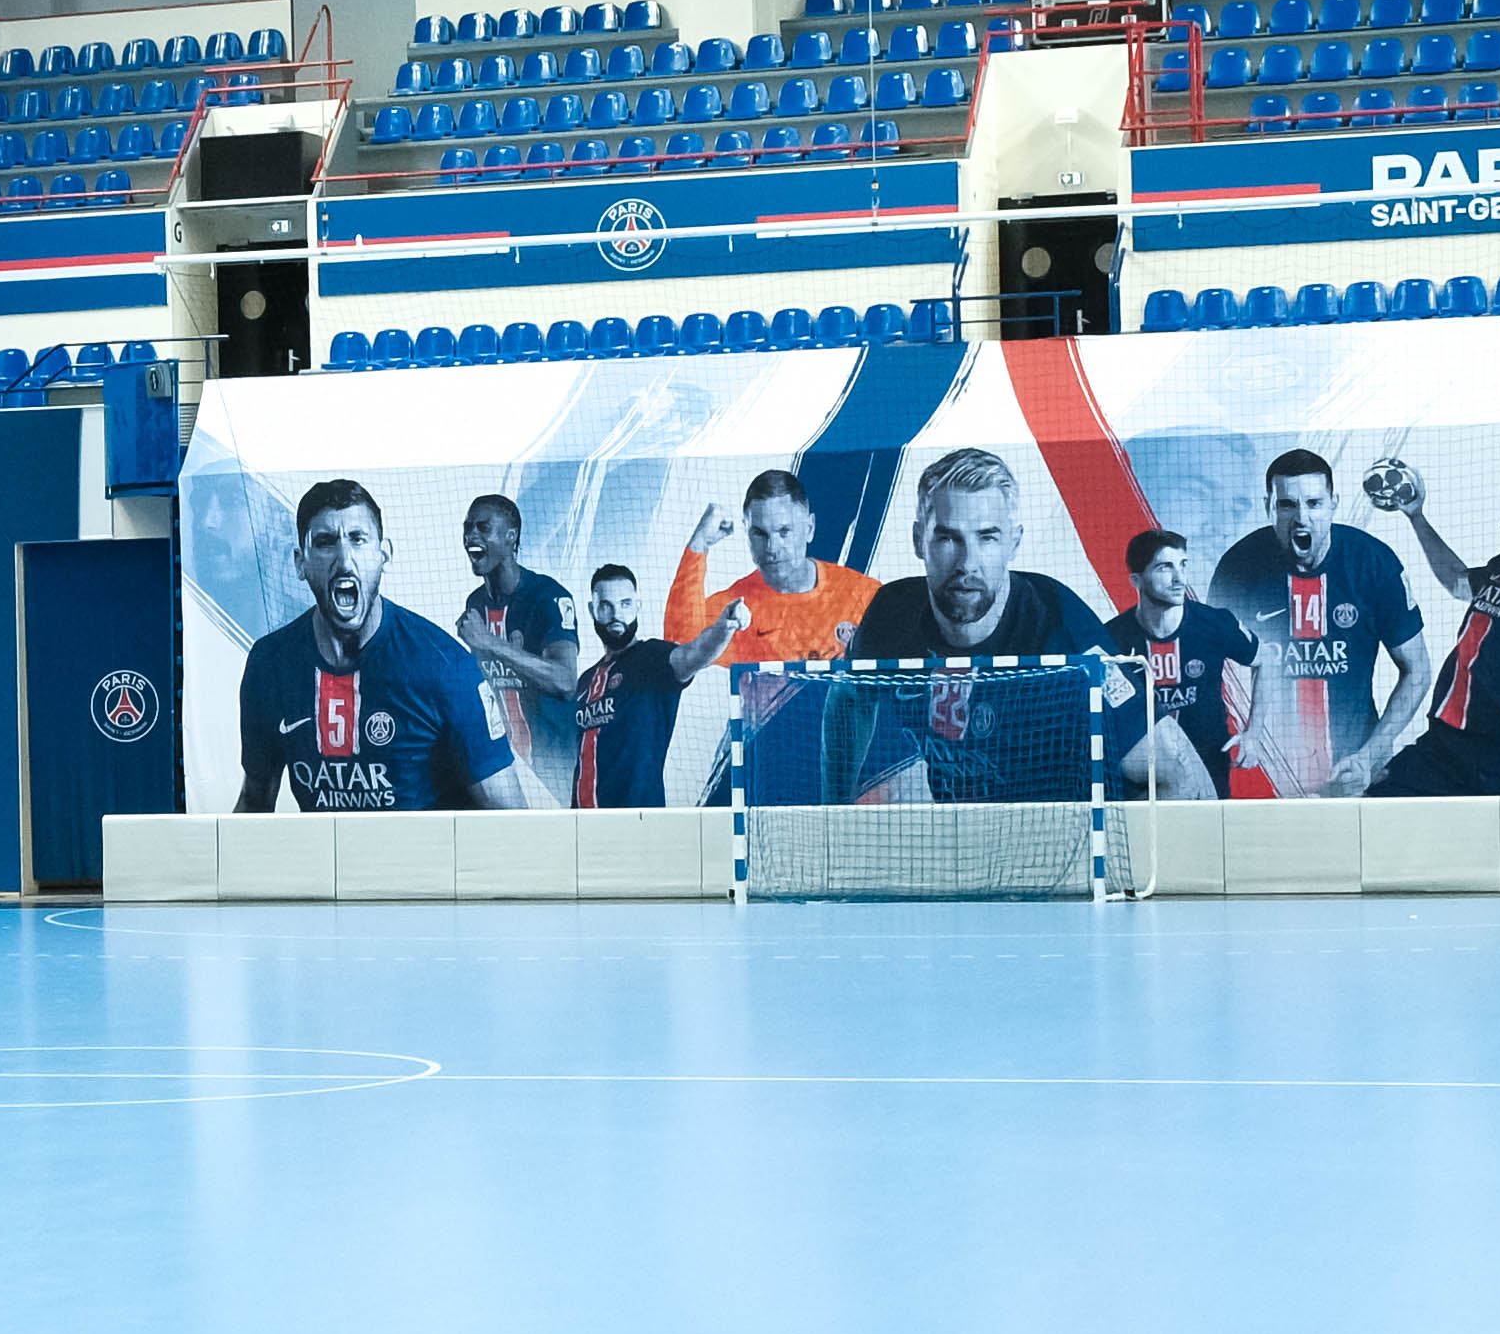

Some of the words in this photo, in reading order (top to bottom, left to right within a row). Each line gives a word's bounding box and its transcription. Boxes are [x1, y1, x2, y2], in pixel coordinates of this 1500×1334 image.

[607, 202, 654, 221] PARIS
[174, 222, 182, 243] G
[1292, 594, 1321, 631] 14
[1151, 653, 1177, 681] 90
[1284, 660, 1349, 676] AIRWAYS
[102, 673, 146, 692] PARIS
[328, 698, 346, 748] 5
[575, 697, 616, 727] QATAR
[293, 761, 393, 792] QATAR
[316, 789, 395, 809] AIRWAYS
